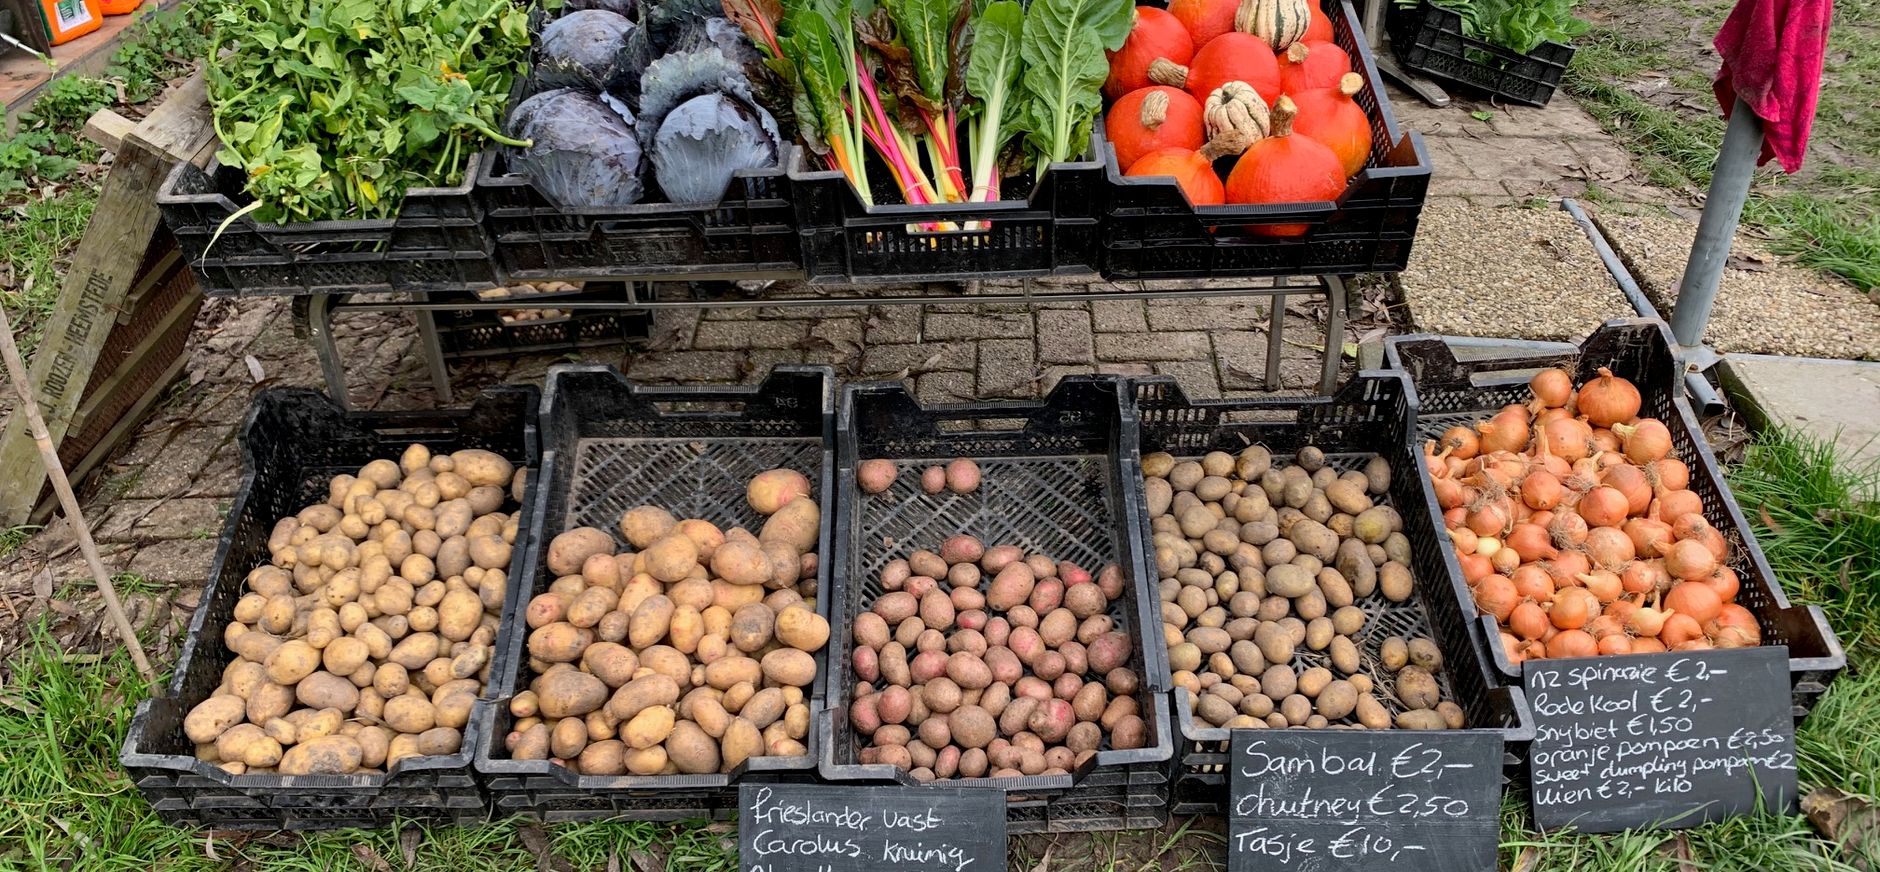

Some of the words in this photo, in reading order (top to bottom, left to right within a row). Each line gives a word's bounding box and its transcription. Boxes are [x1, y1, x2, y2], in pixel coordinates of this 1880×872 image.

[1534, 744, 1610, 767] oranje
[1616, 737, 1719, 761] pompoen
[1600, 756, 1686, 779] dumpling
[1367, 784, 1469, 818] €2,50
[754, 830, 860, 857] Carolus
[1235, 828, 1315, 864] Tasje
